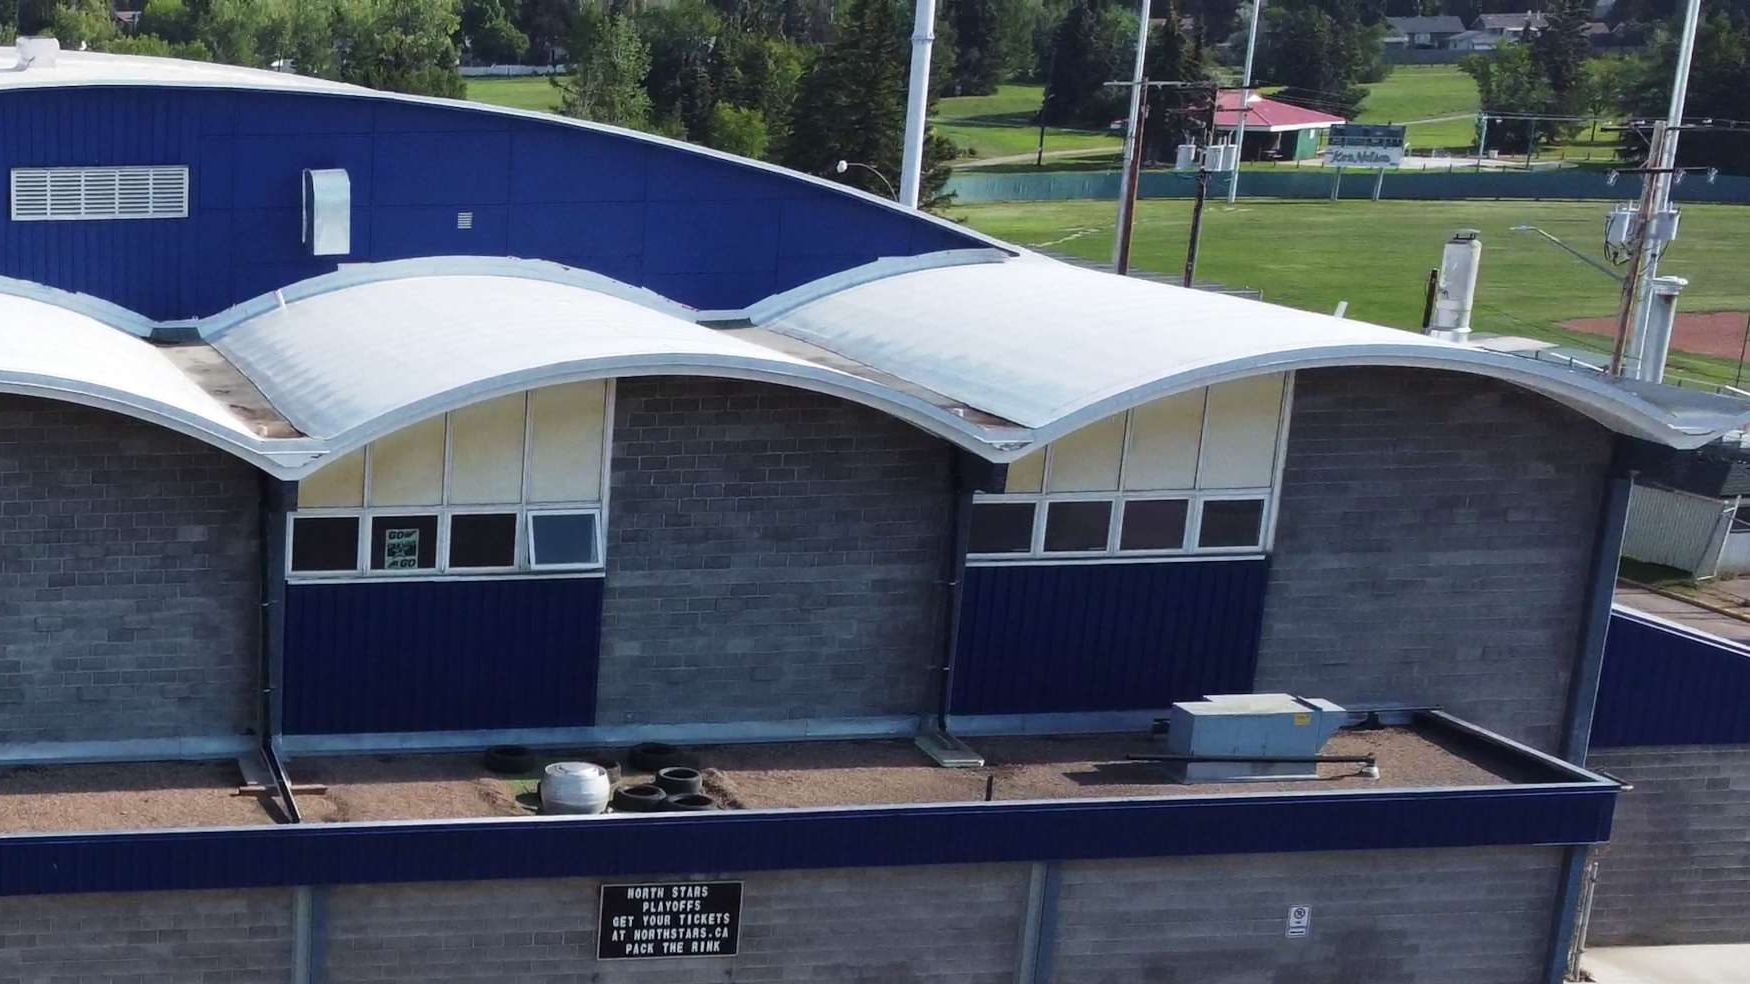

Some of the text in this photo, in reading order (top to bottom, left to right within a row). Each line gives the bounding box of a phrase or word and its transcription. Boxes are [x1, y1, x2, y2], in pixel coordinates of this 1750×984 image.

[388, 530, 404, 540] GO
[627, 886, 708, 899] NORTH STARS
[643, 900, 701, 912] PLAYOFFS
[613, 913, 730, 927] GET YOUR TICKETS
[612, 927, 729, 941] AT NORTHSTARS.CA
[626, 941, 720, 955] PACK THE RINK
